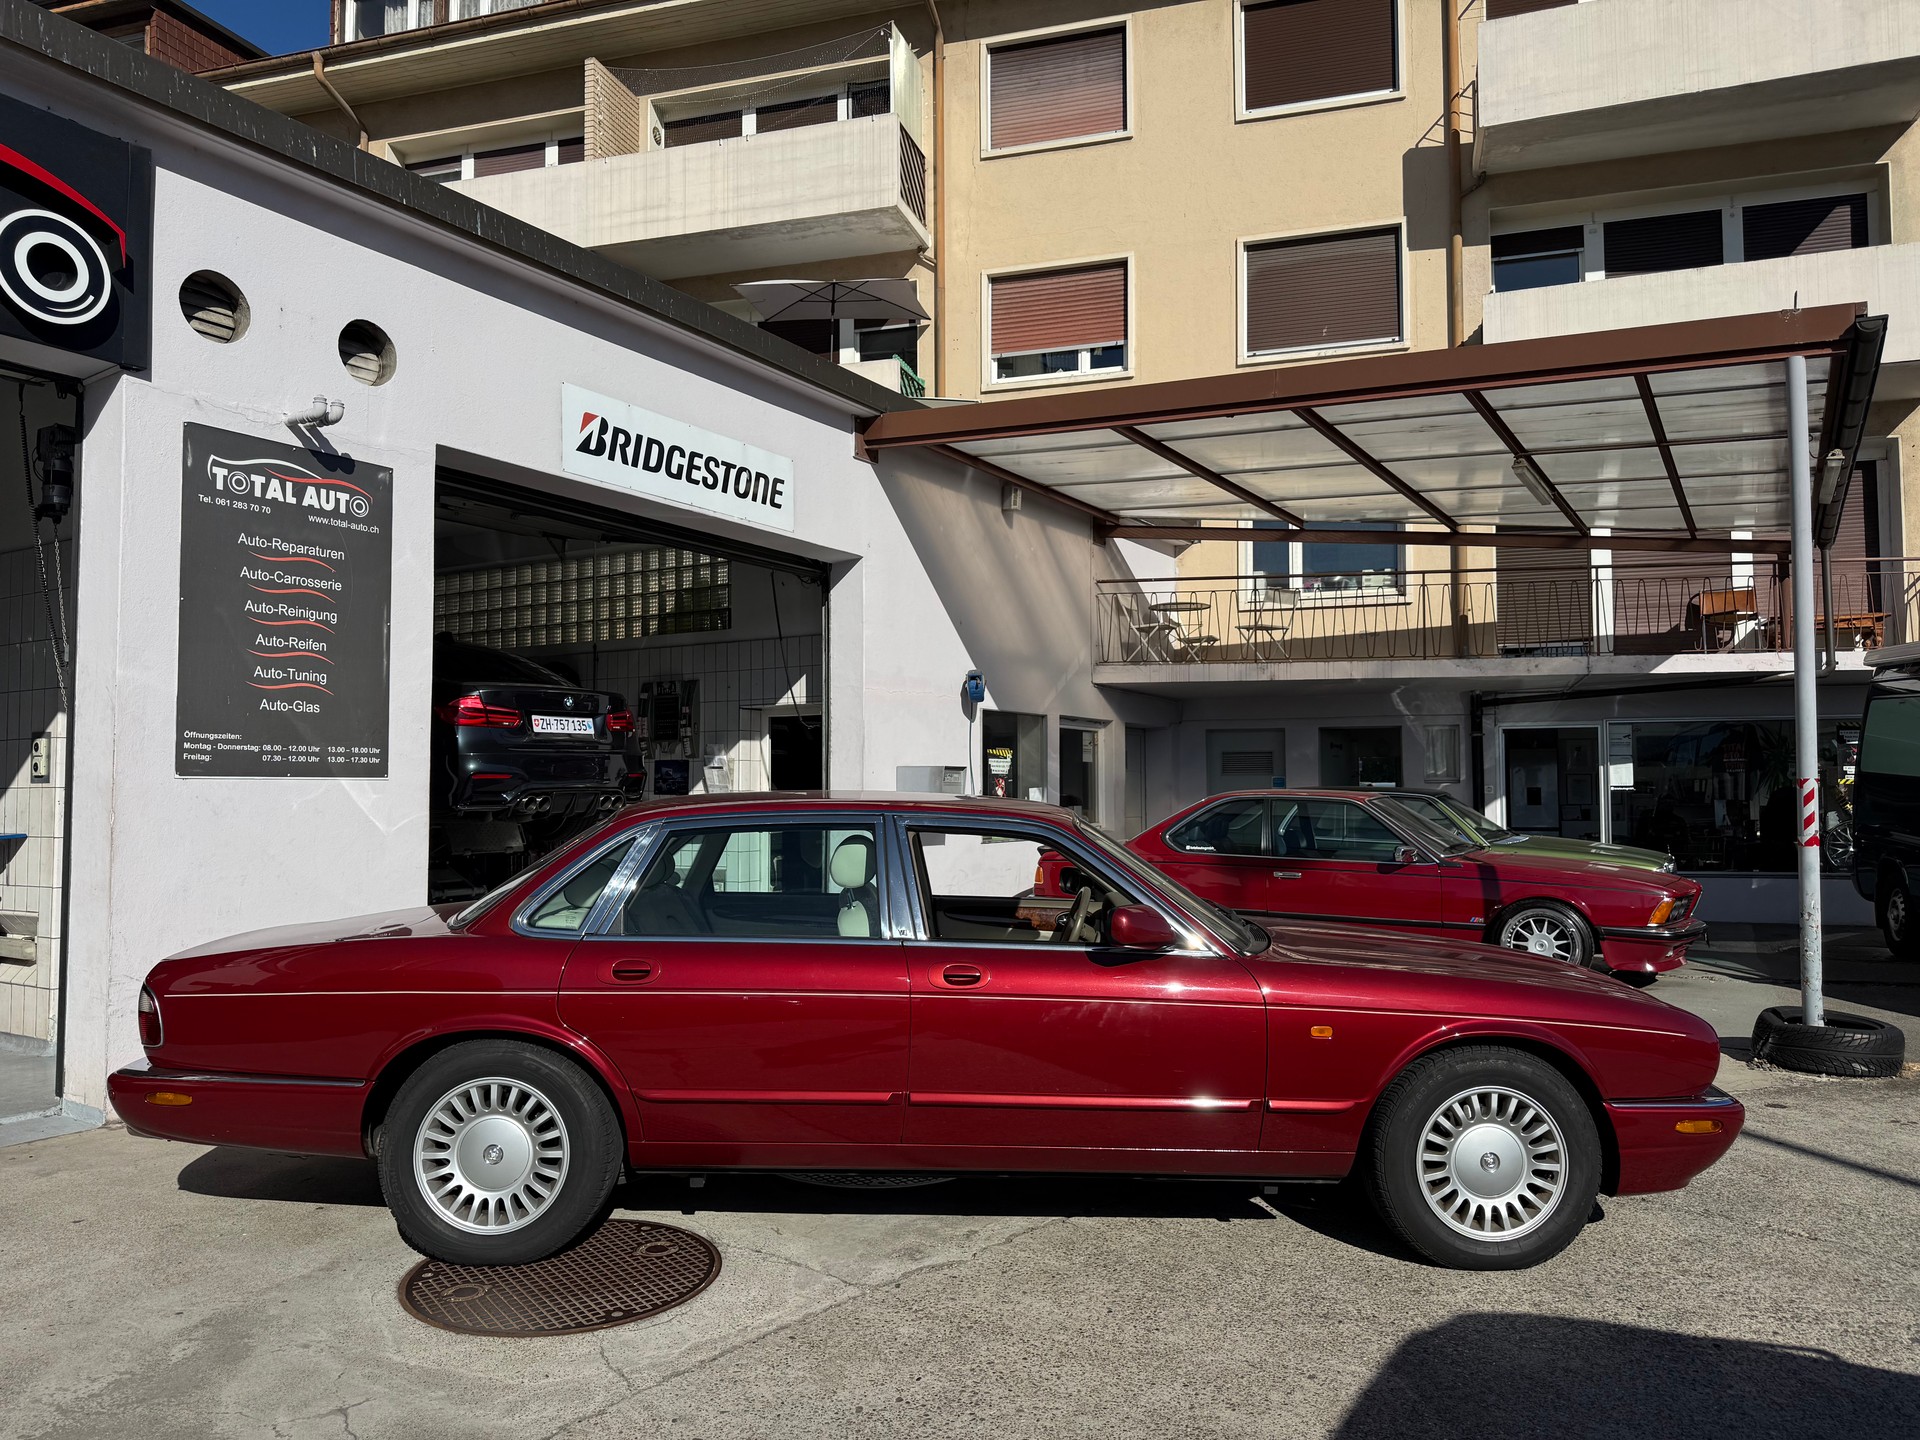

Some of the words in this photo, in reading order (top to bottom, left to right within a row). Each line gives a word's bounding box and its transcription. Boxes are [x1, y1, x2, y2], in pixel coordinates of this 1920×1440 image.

[576, 411, 785, 509] BRIDGESTONE
[212, 466, 297, 504] TOTAL
[302, 485, 369, 518] AUTO
[198, 493, 214, 504] Tel.
[215, 497, 230, 507] 061
[232, 500, 248, 510] 283
[249, 503, 260, 512] 70
[261, 505, 271, 514] 70
[308, 514, 380, 534] www.total-auto.ch
[237, 532, 345, 560] Auto-Reparaturen
[239, 566, 342, 591] Auto-Carrosserie
[244, 599, 338, 624] Auto-Reinigung
[255, 633, 327, 652] Auto-Reifen
[253, 665, 327, 685] Auto-Tuning
[259, 698, 320, 713] Auto-Glas
[183, 730, 242, 741] Öffnungszeiten:
[183, 742, 212, 751] Montag
[217, 743, 261, 753] Donnerstag:
[262, 744, 282, 752] 08.00
[308, 745, 320, 753] Uhr
[183, 753, 212, 762] Freitag:
